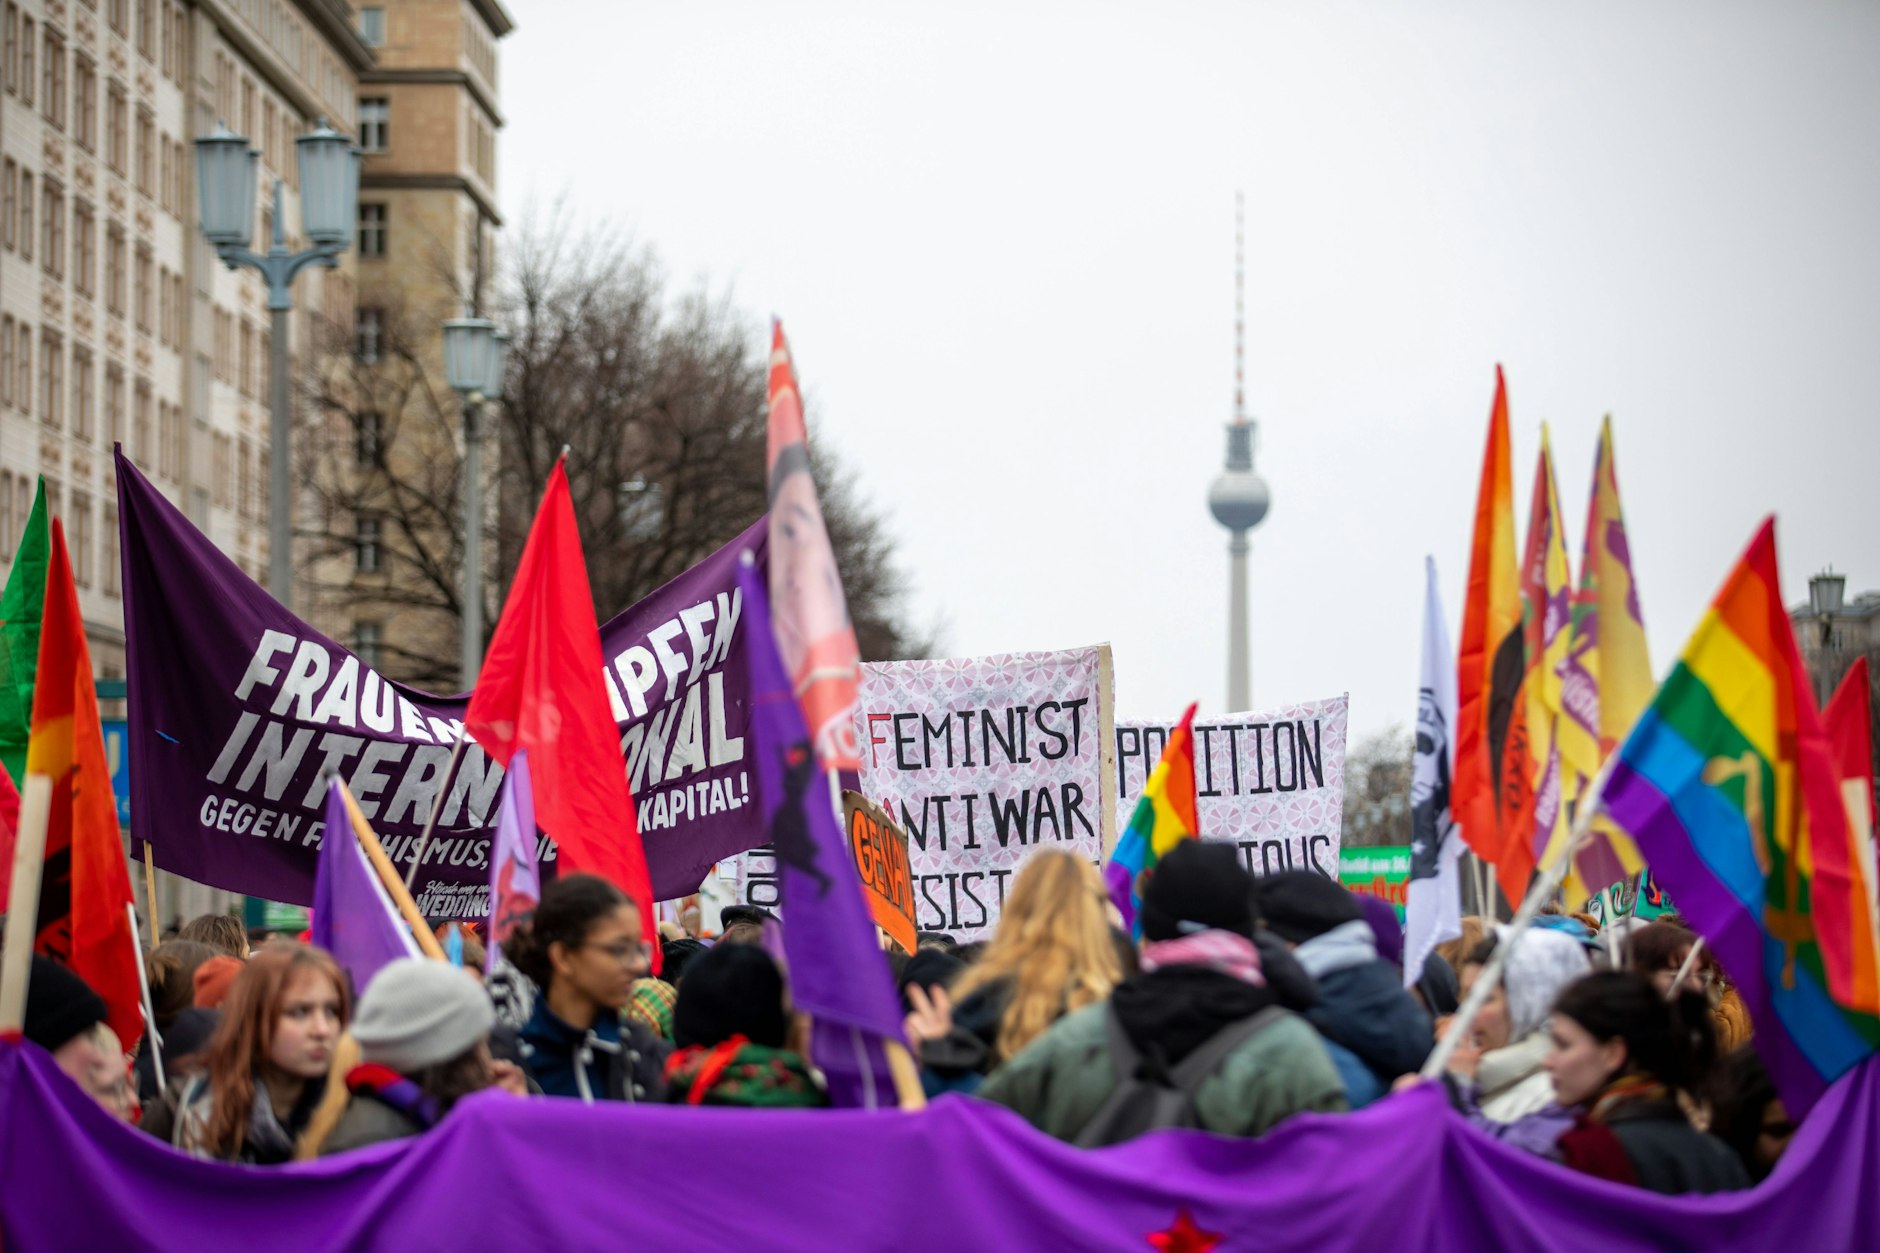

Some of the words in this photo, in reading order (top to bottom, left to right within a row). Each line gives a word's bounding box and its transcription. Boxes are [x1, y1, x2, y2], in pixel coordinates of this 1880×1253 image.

[234, 629, 477, 743] FRAUEN
[867, 697, 1089, 770] FEMINIST
[1116, 720, 1324, 799] POITION
[200, 795, 302, 842] GEGEN
[302, 821, 489, 870] FHISMUS,
[636, 772, 749, 834] KAPITAL!
[416, 894, 491, 917] WEDDING
